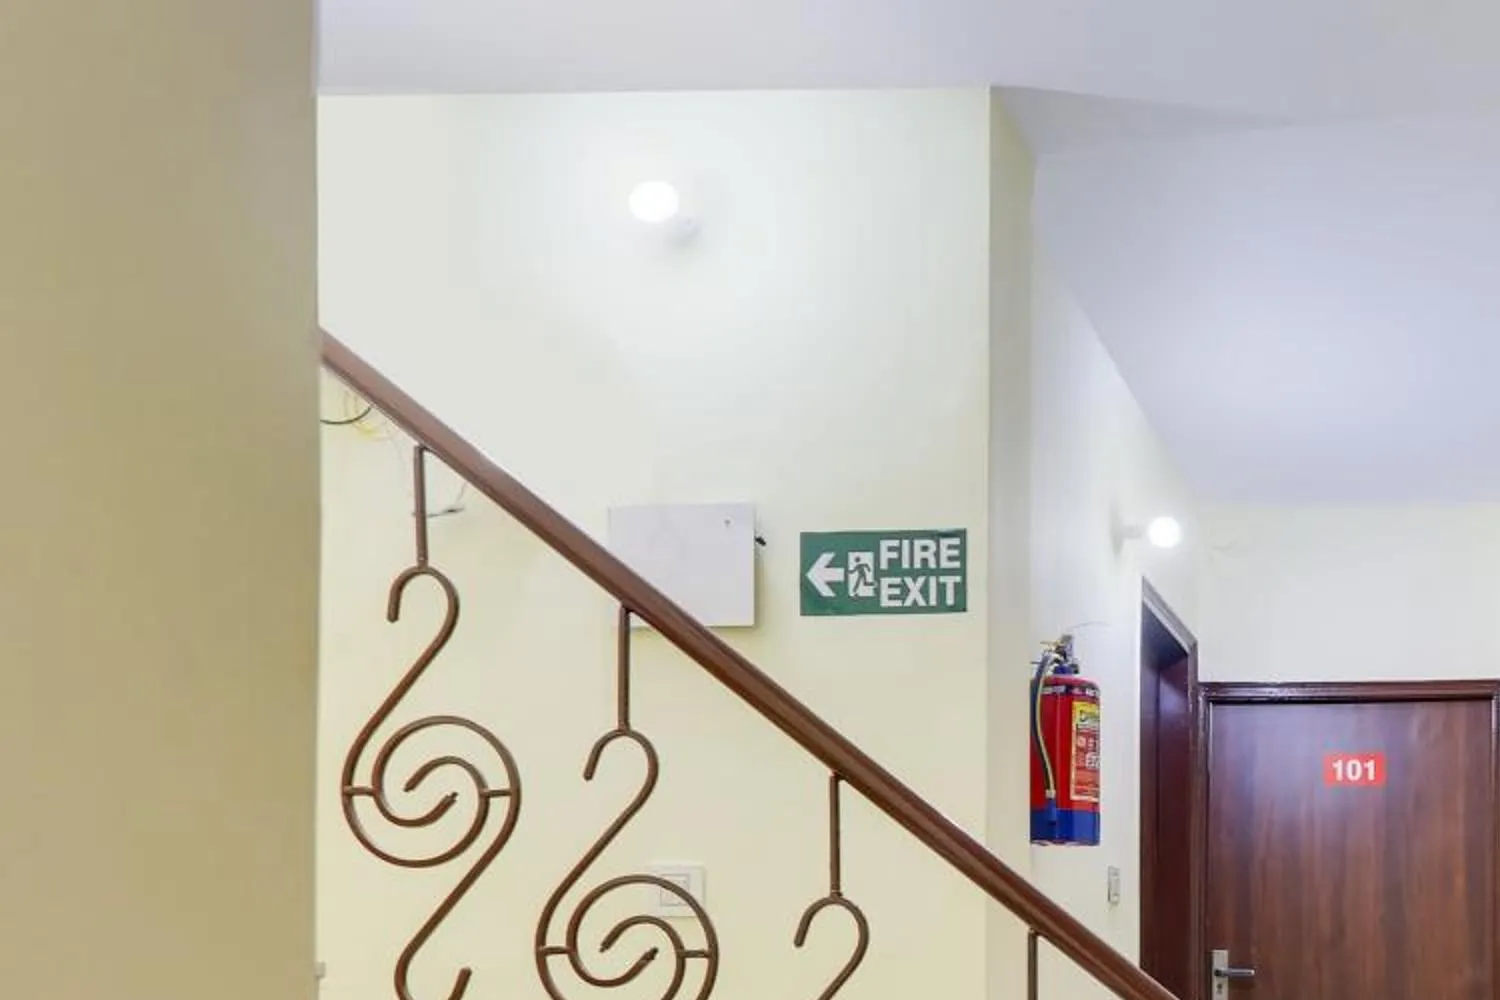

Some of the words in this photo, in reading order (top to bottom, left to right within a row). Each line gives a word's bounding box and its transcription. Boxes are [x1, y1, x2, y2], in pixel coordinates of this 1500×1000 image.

[879, 537, 961, 570] FIRE
[879, 576, 962, 607] EXIT
[1331, 759, 1375, 781] 101
